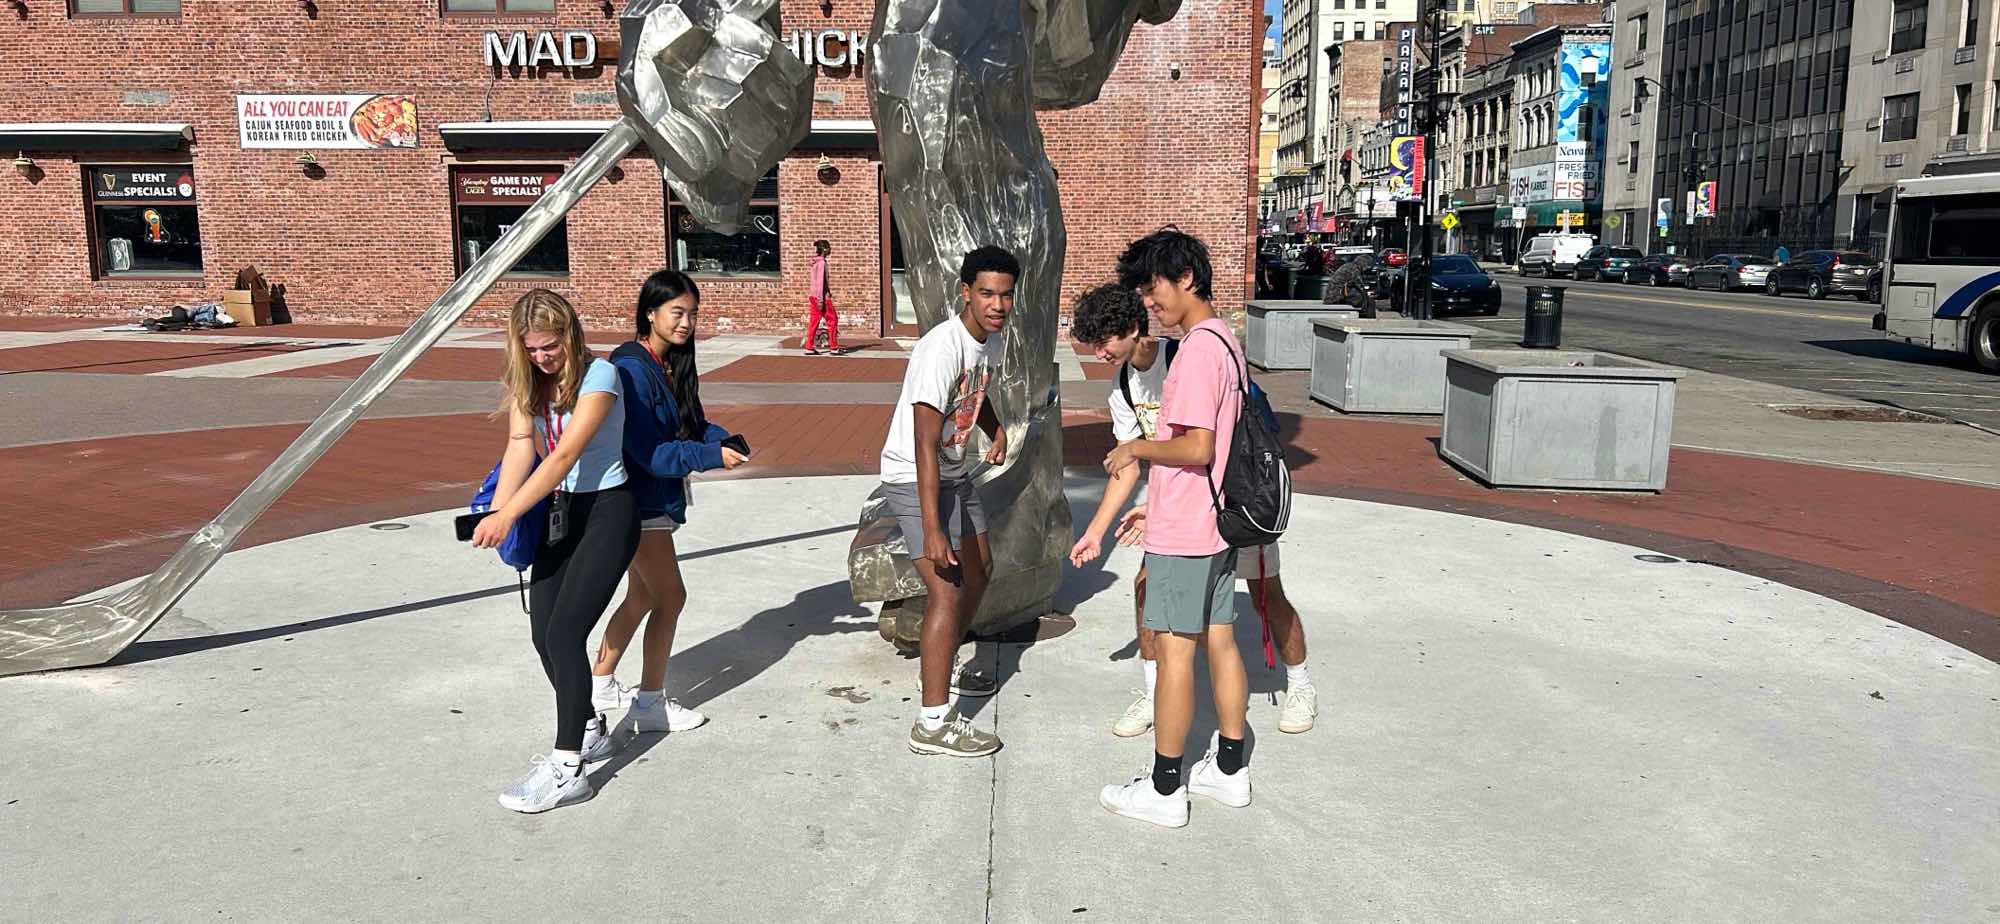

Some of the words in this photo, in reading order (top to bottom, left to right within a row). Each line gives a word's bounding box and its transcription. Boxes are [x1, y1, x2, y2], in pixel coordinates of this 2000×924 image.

[483, 30, 596, 66] MAD
[269, 101, 296, 117] YOU
[298, 101, 324, 117] CAN
[326, 101, 348, 117] EAT
[245, 120, 272, 130] CAJUN
[275, 120, 312, 130] SEAFOOD
[316, 120, 335, 130] BOIL
[338, 120, 344, 130] &
[247, 132, 280, 142] KOREAN
[283, 132, 308, 142] FRIED
[311, 132, 347, 142] CHICKEN
[1558, 163, 1588, 172] FRESH
[131, 173, 167, 183] EVENT
[490, 176, 520, 185] GAME
[522, 176, 543, 185] DAY
[1567, 171, 1595, 180] FRIED
[124, 187, 177, 197] SPECIALS!
[492, 187, 541, 196] SPECIALS!
[1555, 182, 1598, 198] FISH
